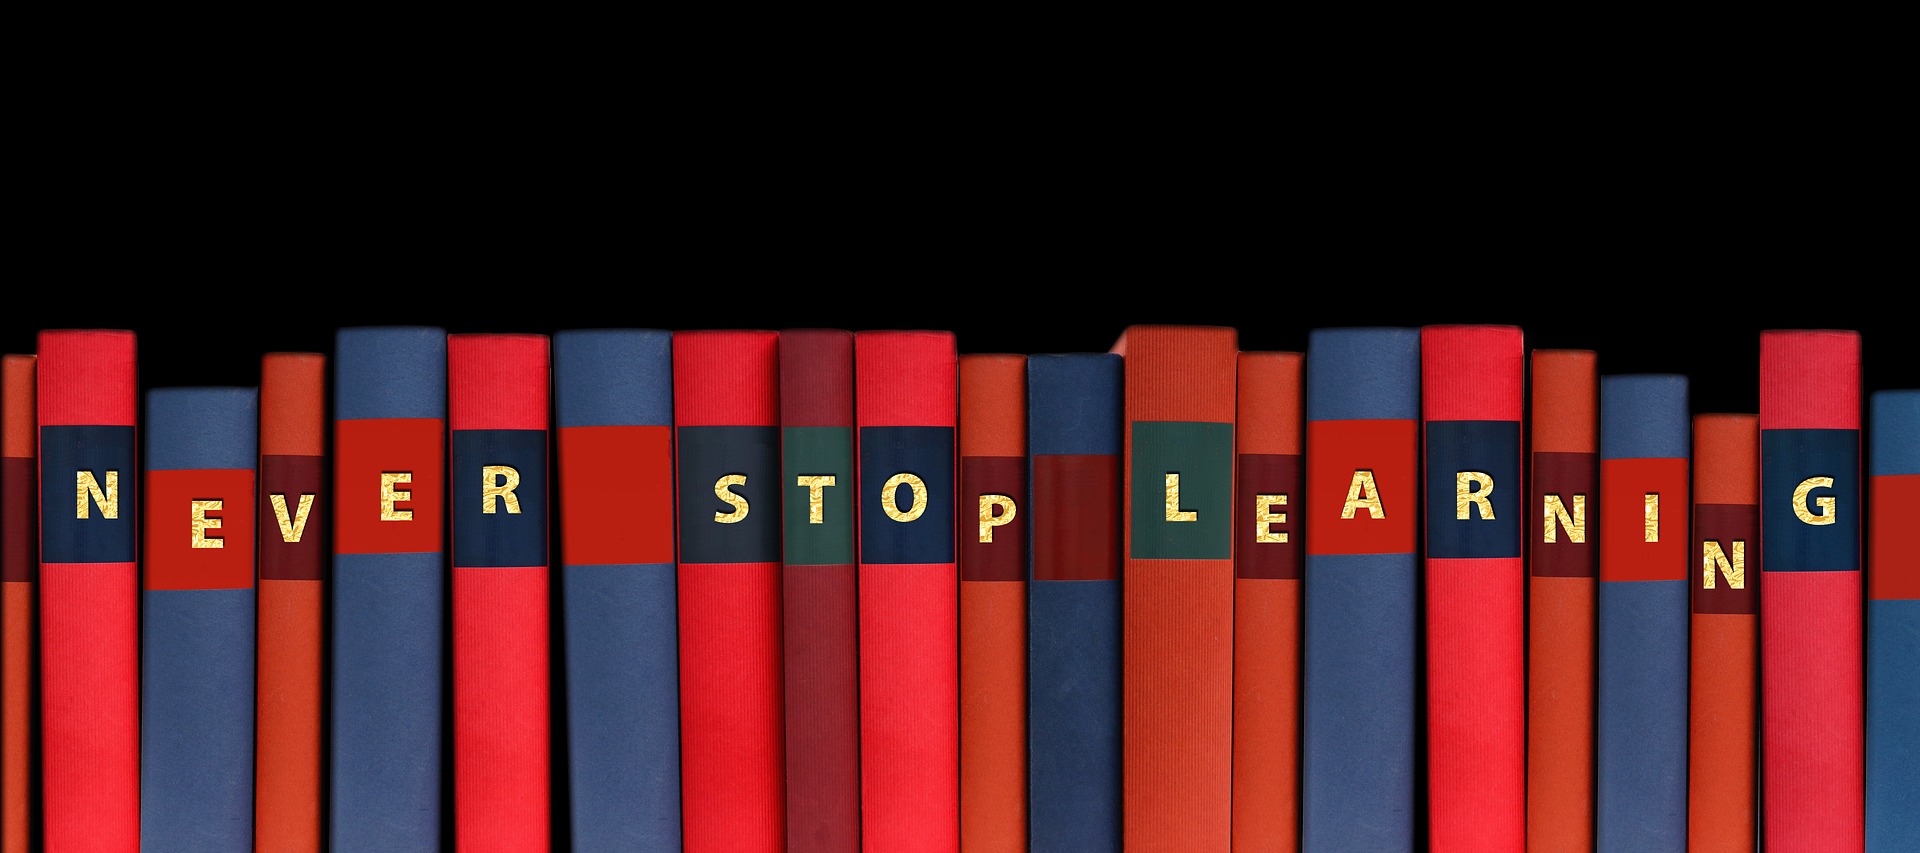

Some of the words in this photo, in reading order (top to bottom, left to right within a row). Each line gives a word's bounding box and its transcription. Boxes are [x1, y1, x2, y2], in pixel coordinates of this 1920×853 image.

[76, 465, 522, 549] NEVER
[713, 472, 1017, 543] STOP
[1165, 470, 1836, 590] LEARNING
